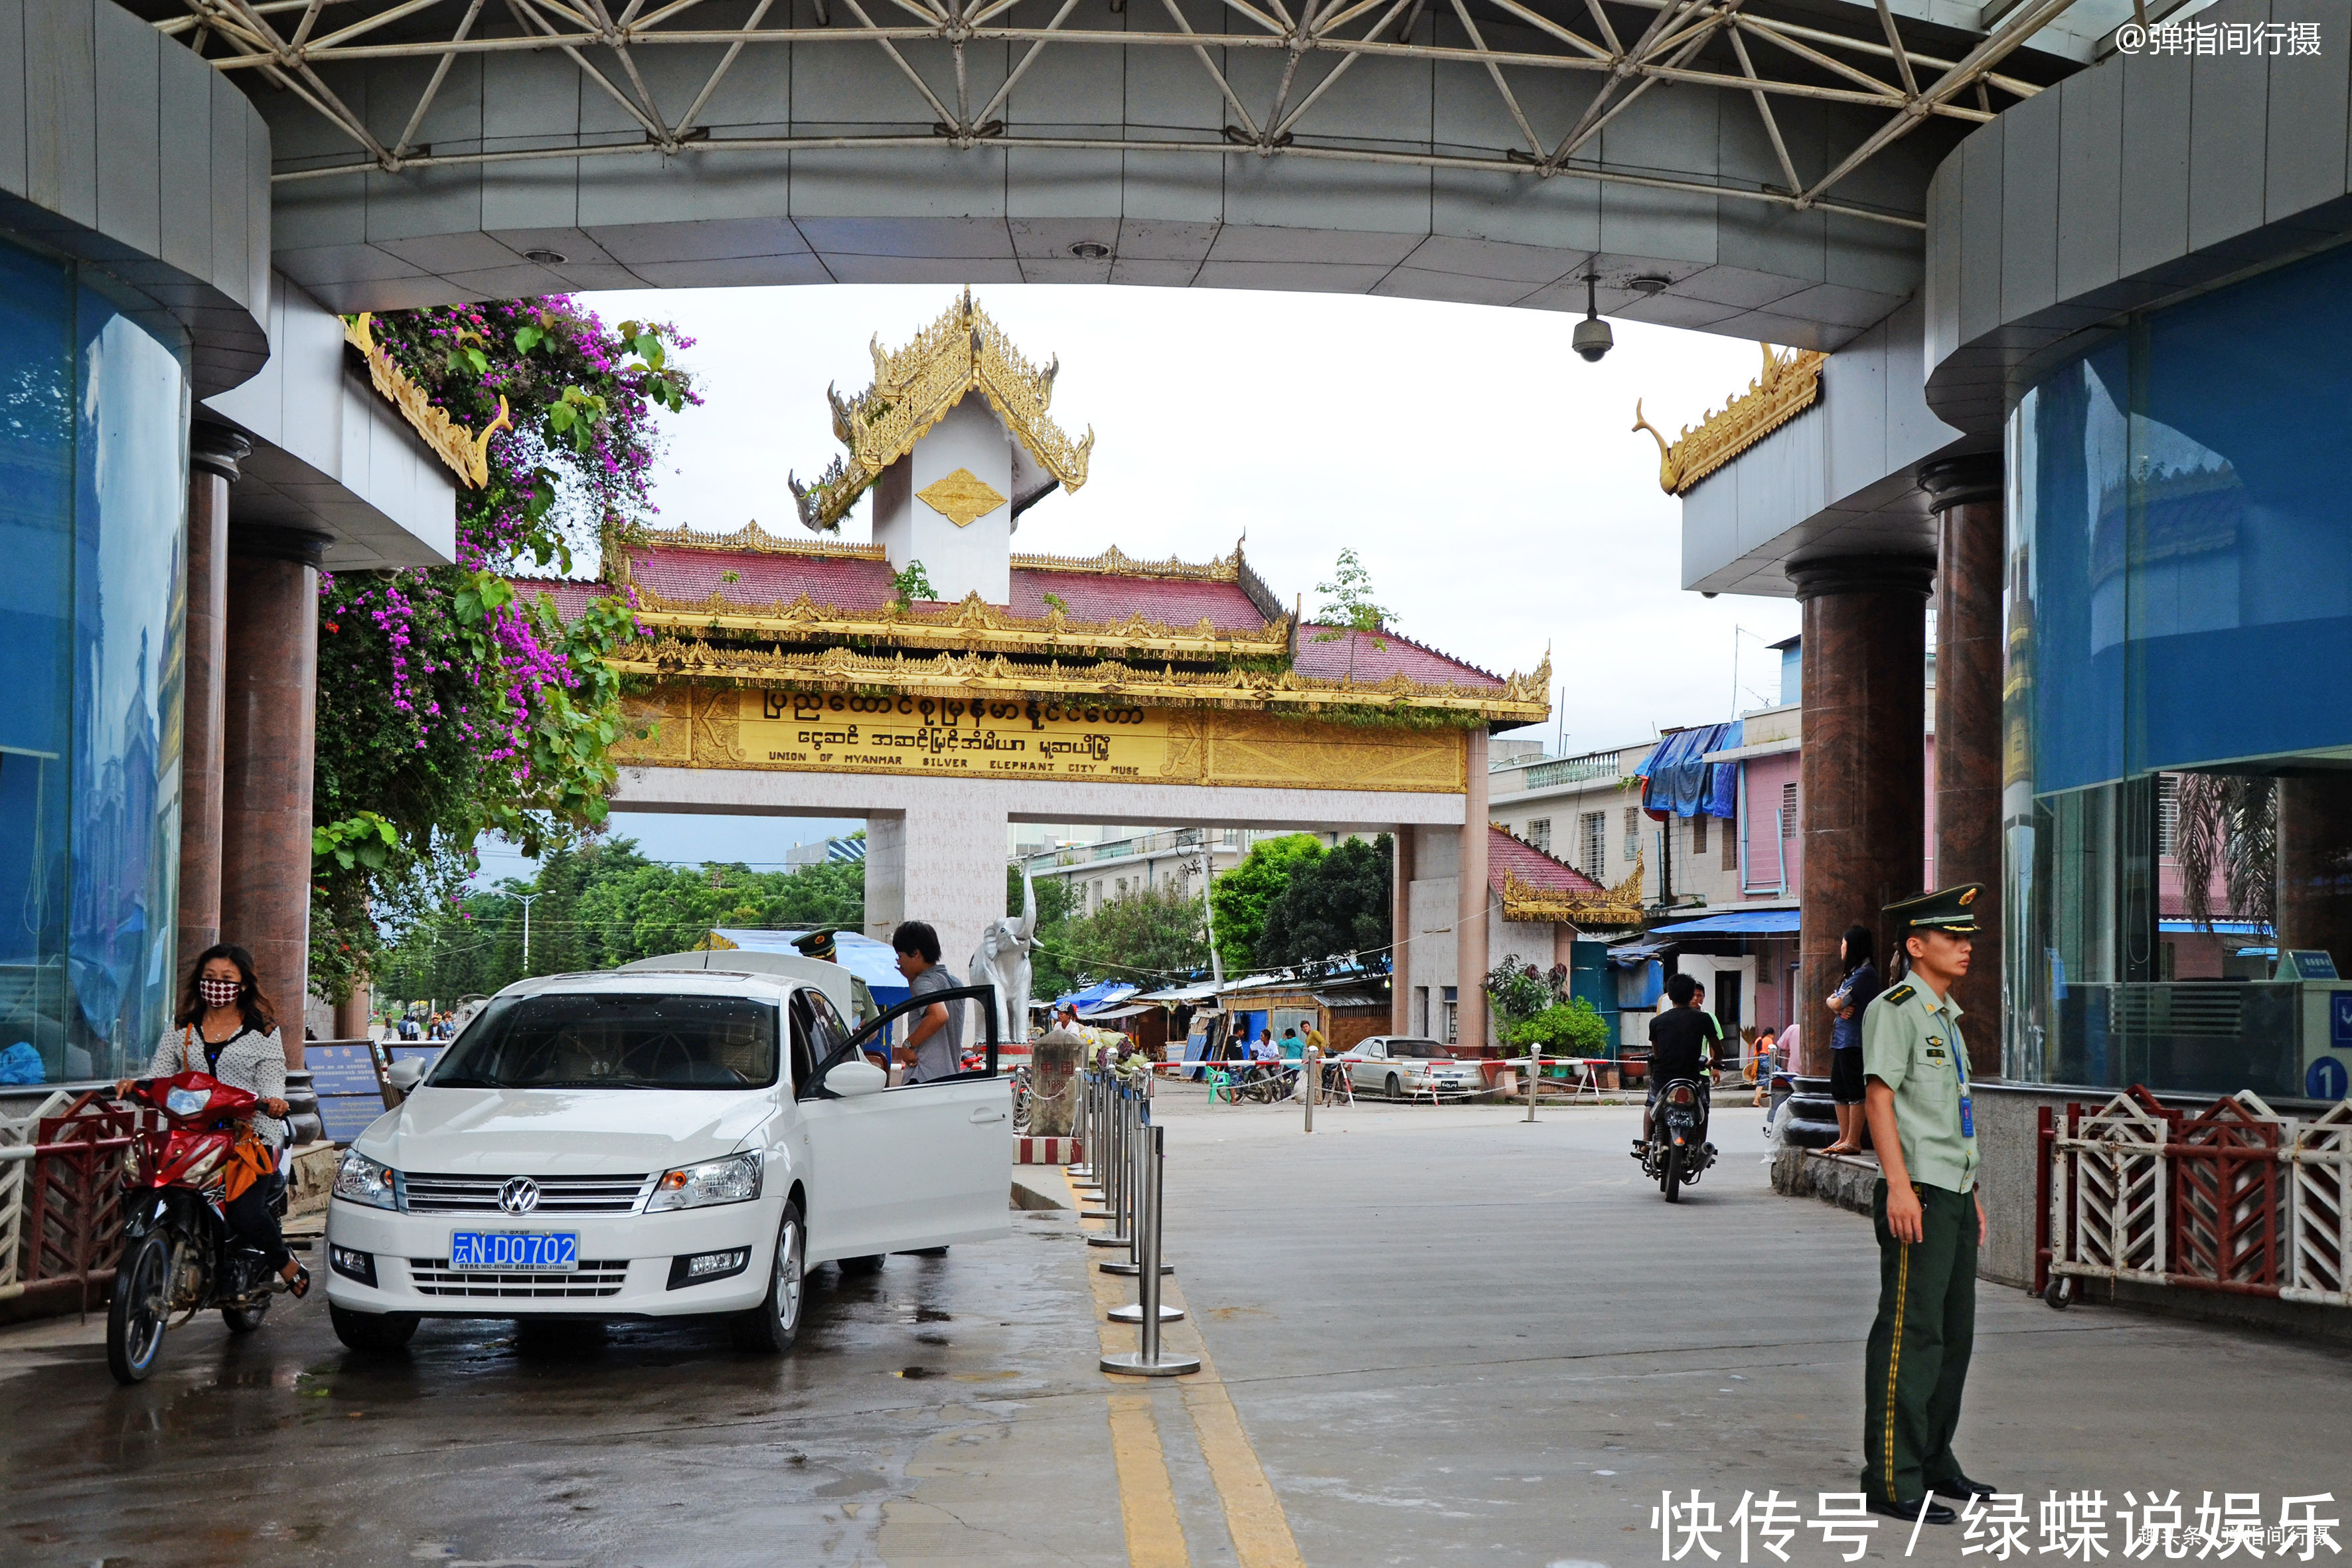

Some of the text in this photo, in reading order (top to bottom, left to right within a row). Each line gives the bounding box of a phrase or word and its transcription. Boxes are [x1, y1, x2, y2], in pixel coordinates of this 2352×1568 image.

[769, 751, 1139, 775] UNION OF MYANMAR SILVER ELEPHANT CITY MUSE
[1040, 1060, 1073, 1075] 中国
[2318, 1065, 2332, 1098] 1
